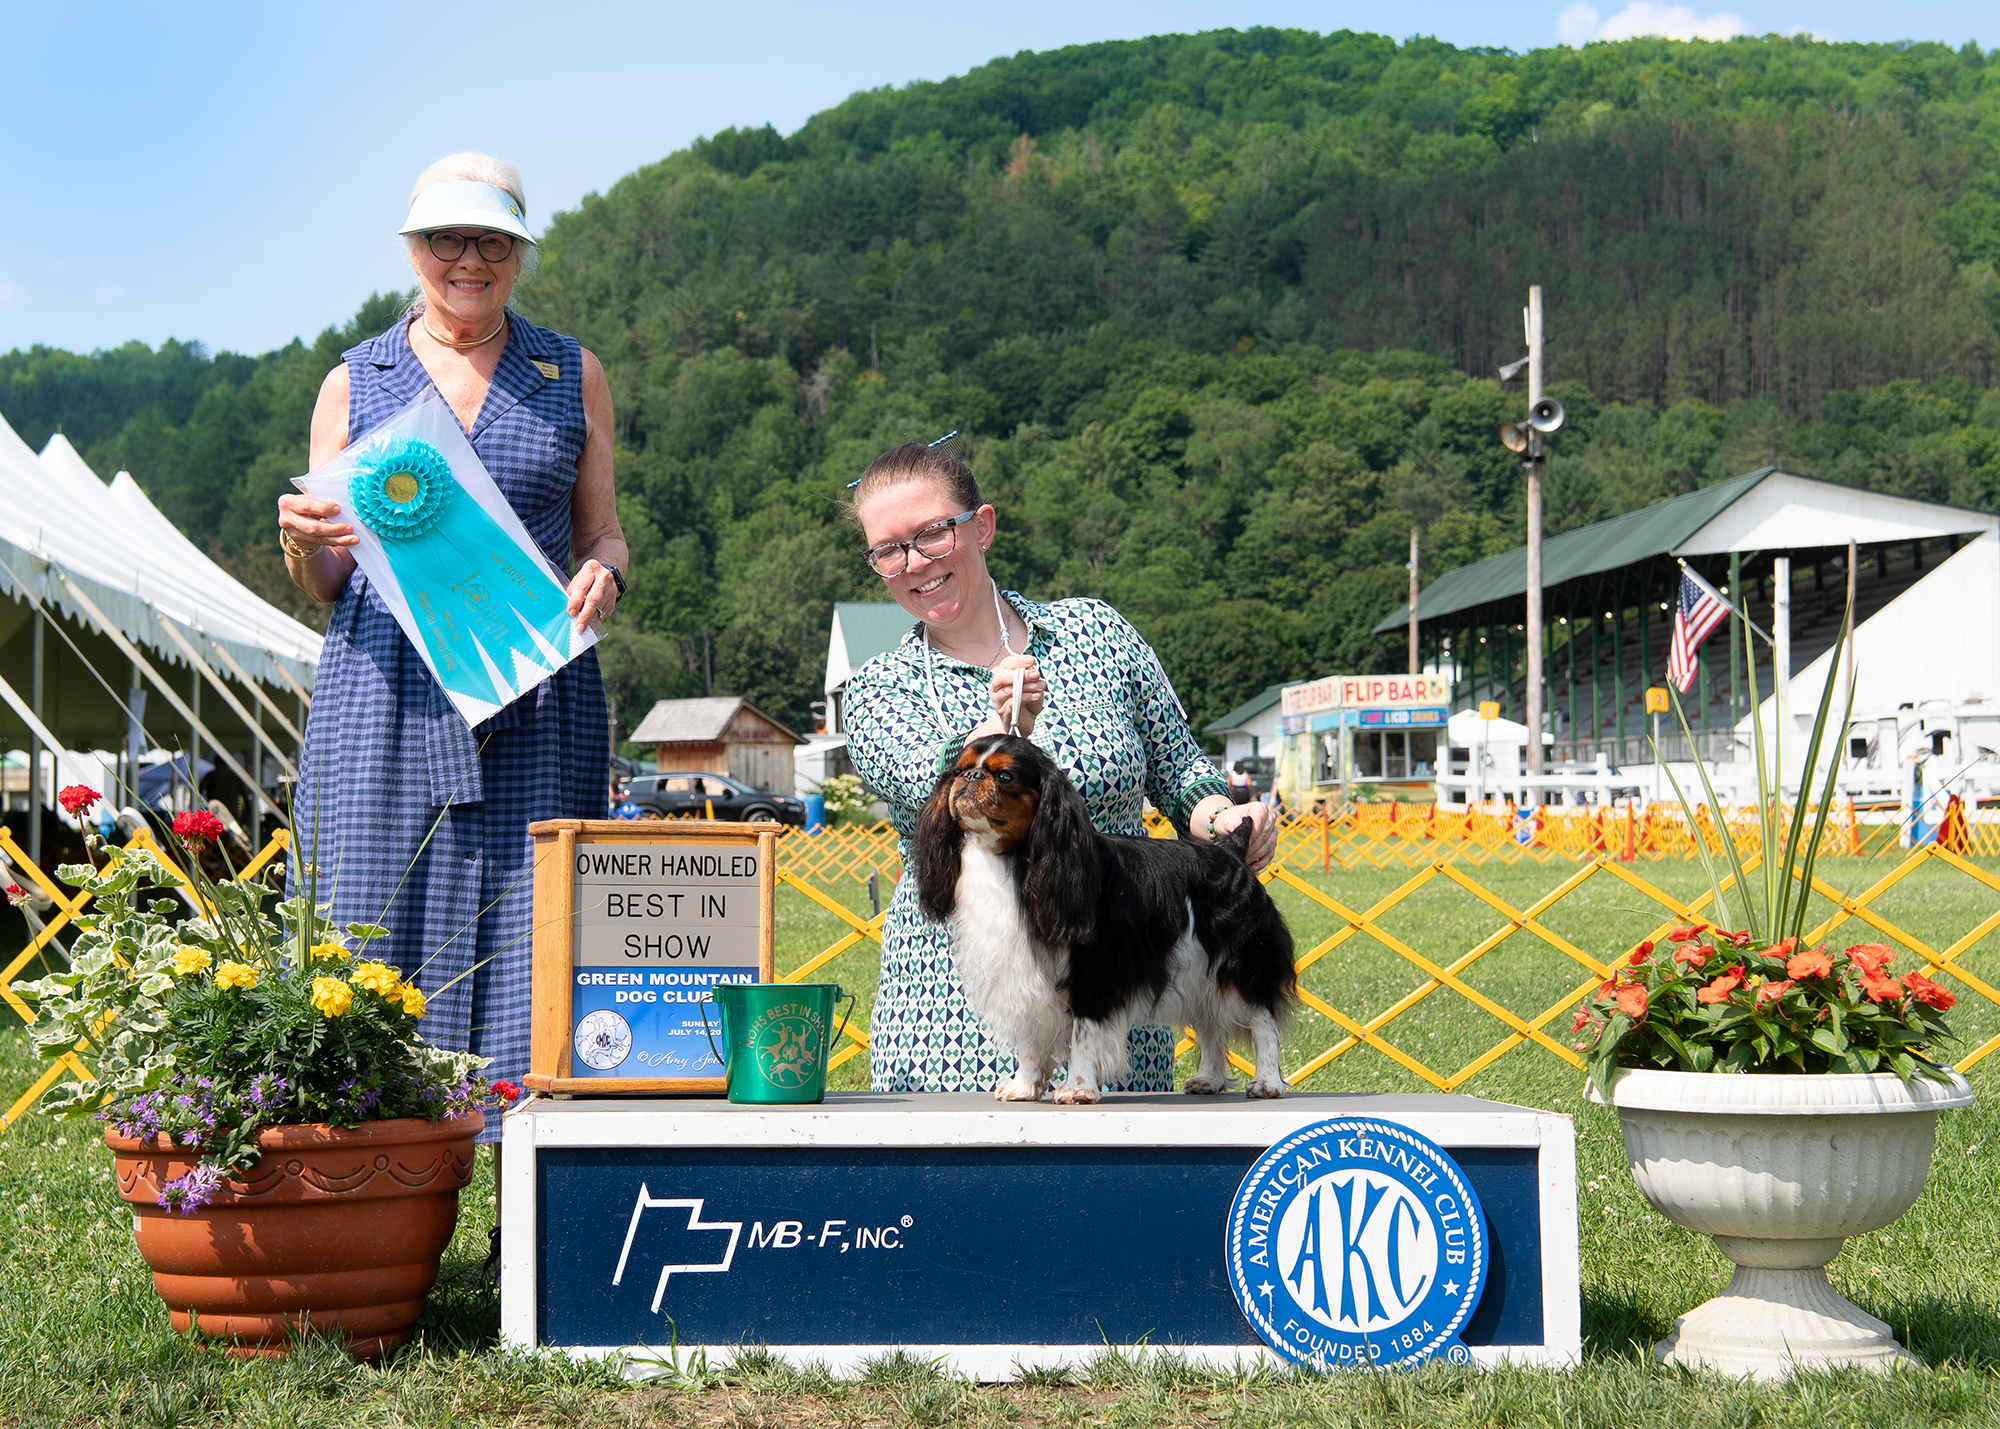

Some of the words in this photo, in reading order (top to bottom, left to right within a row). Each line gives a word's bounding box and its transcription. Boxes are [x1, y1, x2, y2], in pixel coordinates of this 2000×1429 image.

[503, 564, 526, 587] 2024
[416, 591, 437, 625] Handled
[442, 610, 457, 632] Show
[432, 626, 448, 652] Owner
[451, 632, 461, 642] in
[442, 651, 457, 671] Best
[1345, 682, 1384, 701] FLIP
[1388, 681, 1428, 700] BAR
[1366, 711, 1384, 724] HOT
[1410, 711, 1440, 723] DRINKS
[576, 853, 652, 876] OWNER
[660, 855, 757, 878] HANDLED
[607, 893, 685, 918] BEST
[700, 894, 726, 919] IN
[624, 934, 711, 959] SHOW
[576, 972, 644, 986] GREEN
[649, 973, 753, 986] MOUNTAIN
[615, 990, 659, 1004] DOG
[662, 990, 714, 1004] CLUB
[681, 1020, 719, 1028] SUNDAY
[745, 1015, 768, 1049] NOHS
[766, 1003, 798, 1021] BEST
[799, 1004, 812, 1018] IN
[810, 1011, 827, 1047] SHOW
[1248, 1141, 1332, 1268] AMERICAN
[1337, 1137, 1441, 1195] KENNEL
[1434, 1193, 1466, 1266] CLUB
[1287, 1175, 1428, 1329] AKC
[1283, 1318, 1382, 1360] FOUNDED
[1390, 1319, 1435, 1353] 1884
